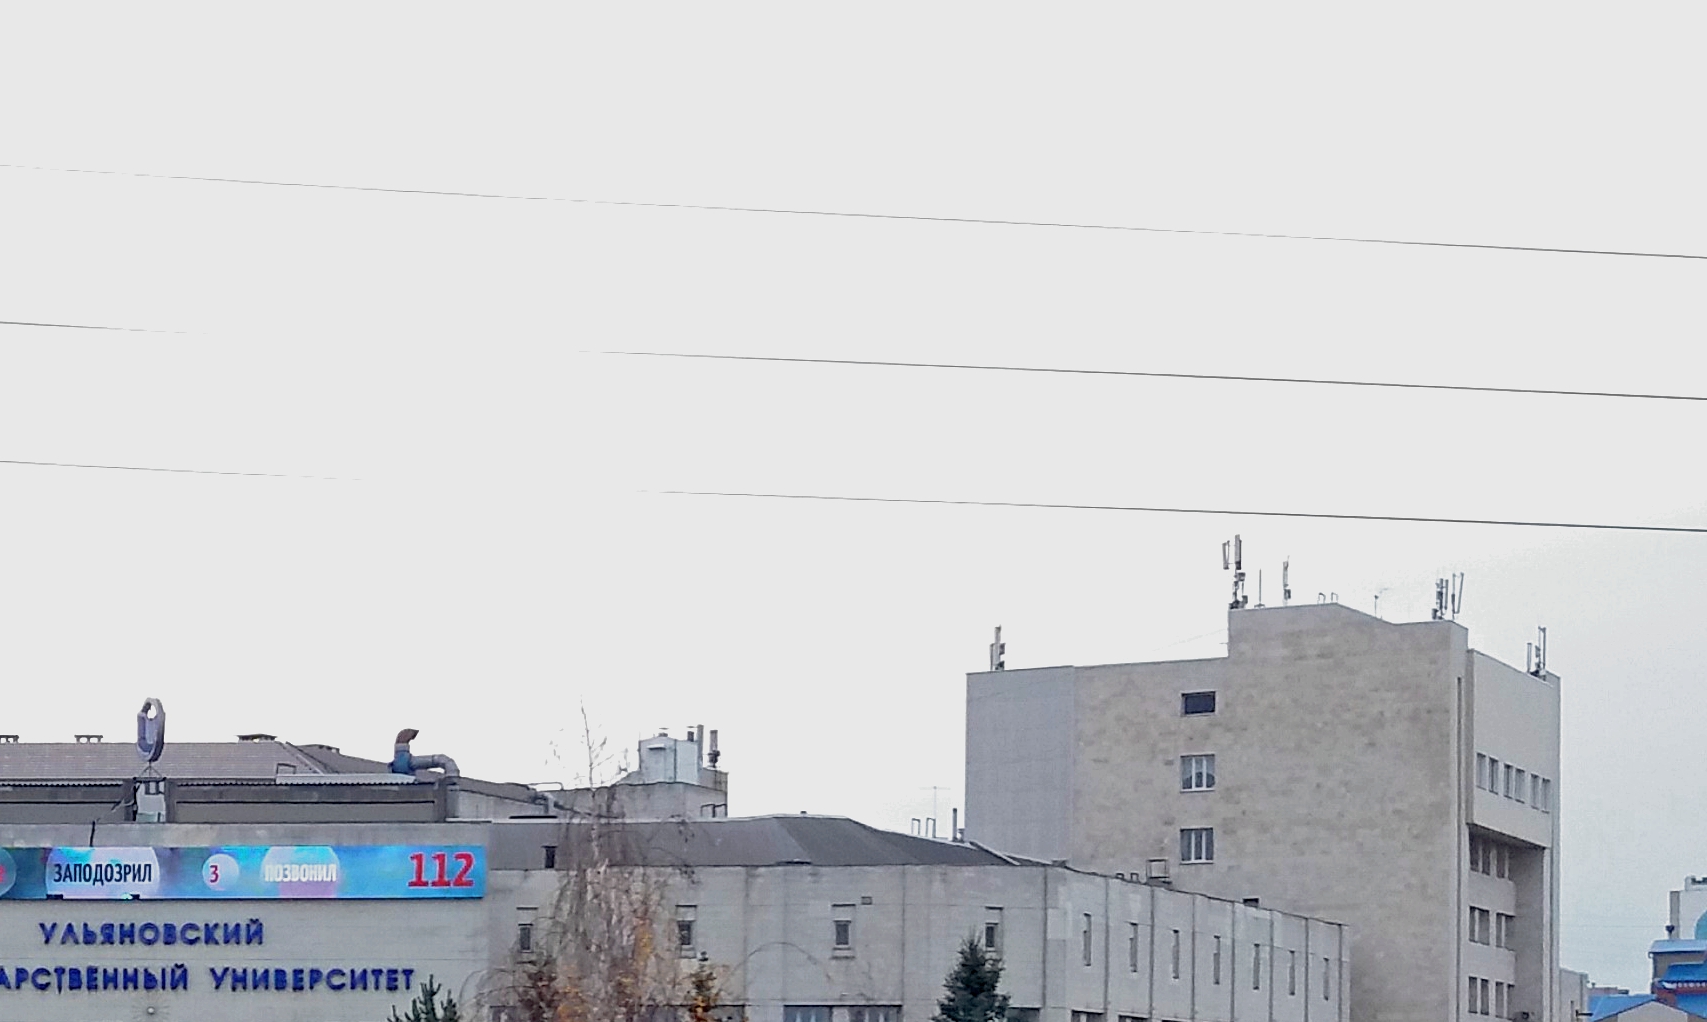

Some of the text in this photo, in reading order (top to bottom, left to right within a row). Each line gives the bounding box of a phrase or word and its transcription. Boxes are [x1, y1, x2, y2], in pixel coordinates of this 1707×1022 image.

[53, 863, 152, 886] ЗАПОДОЗРИЛ
[209, 864, 220, 883] 3
[264, 864, 337, 882] ПОЗВОНИЛ
[407, 852, 475, 888] 112
[39, 918, 264, 945] УЛЬЯНОВСКИЙ
[209, 966, 415, 992] УНИВЕРСИТЕТ
